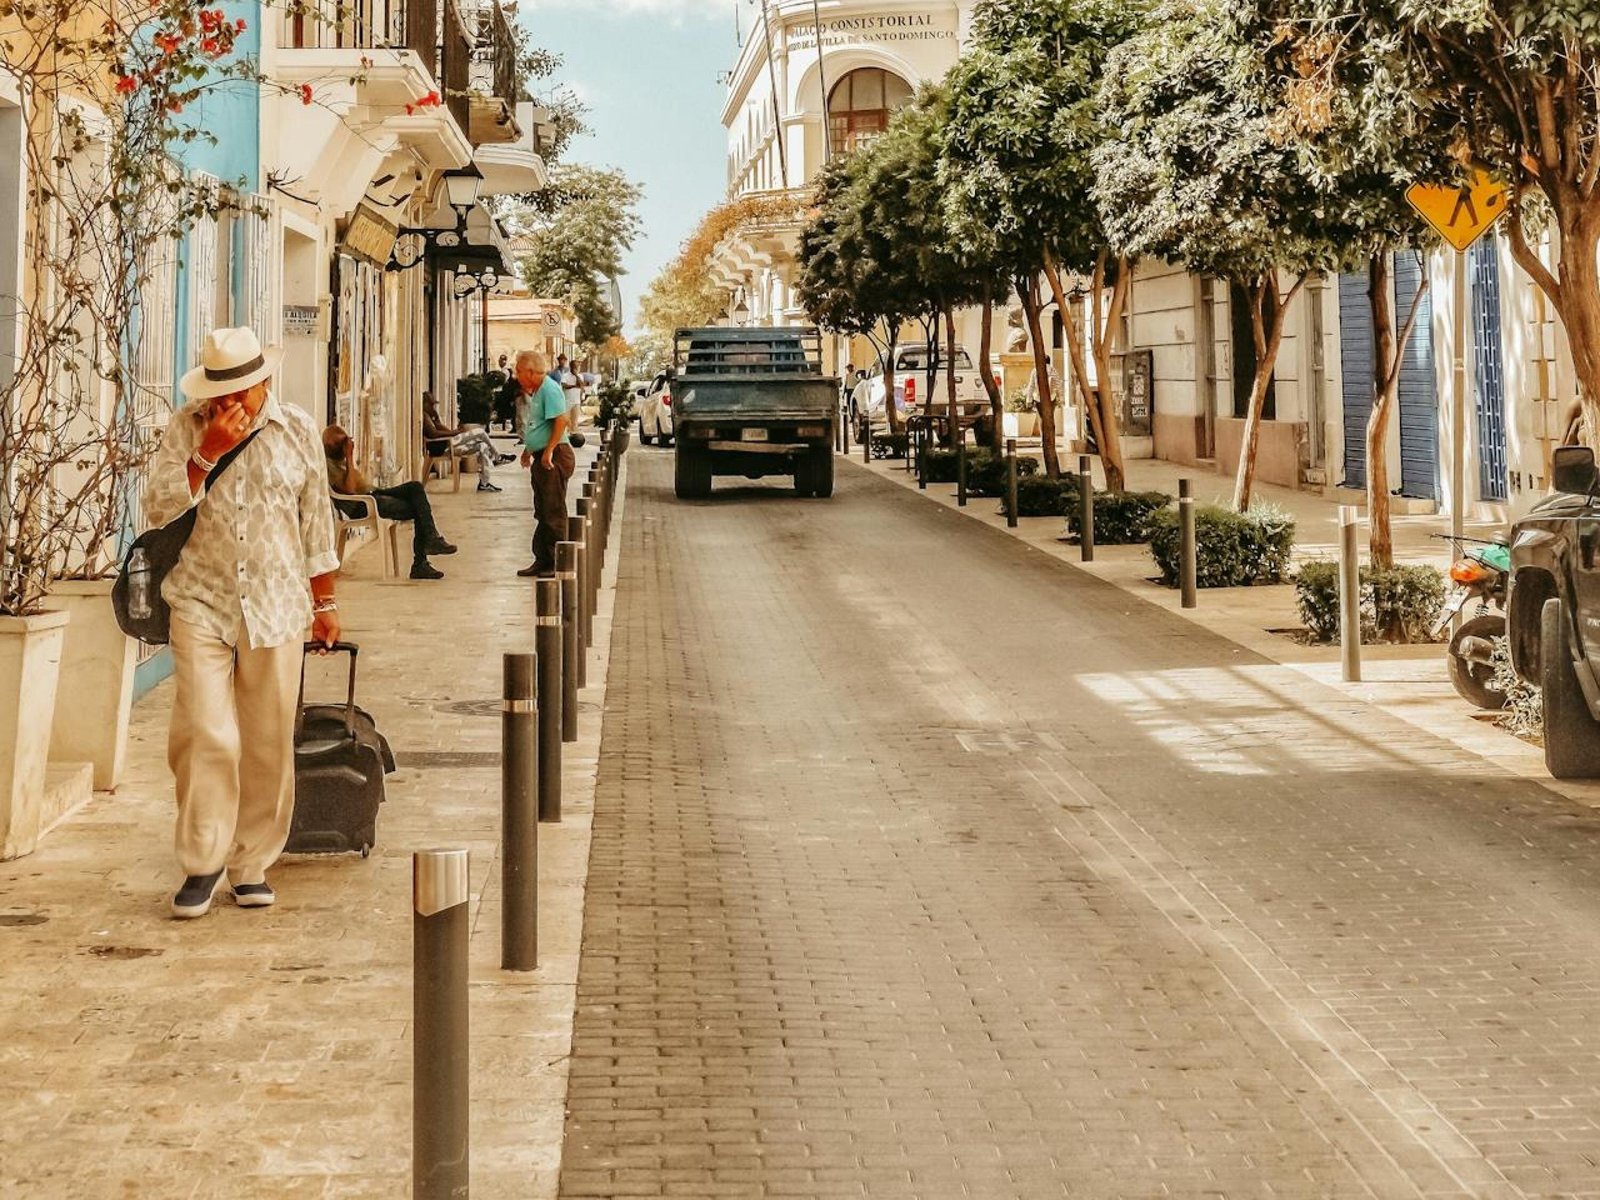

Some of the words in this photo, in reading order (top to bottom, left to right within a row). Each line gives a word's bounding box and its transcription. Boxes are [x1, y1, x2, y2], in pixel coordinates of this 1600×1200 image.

[790, 23, 826, 38] ALACO
[831, 14, 934, 32] CONSISTORIAL
[820, 36, 846, 46] VILLA
[862, 32, 897, 41] SANTO
[899, 30, 954, 41] DOMINGO
